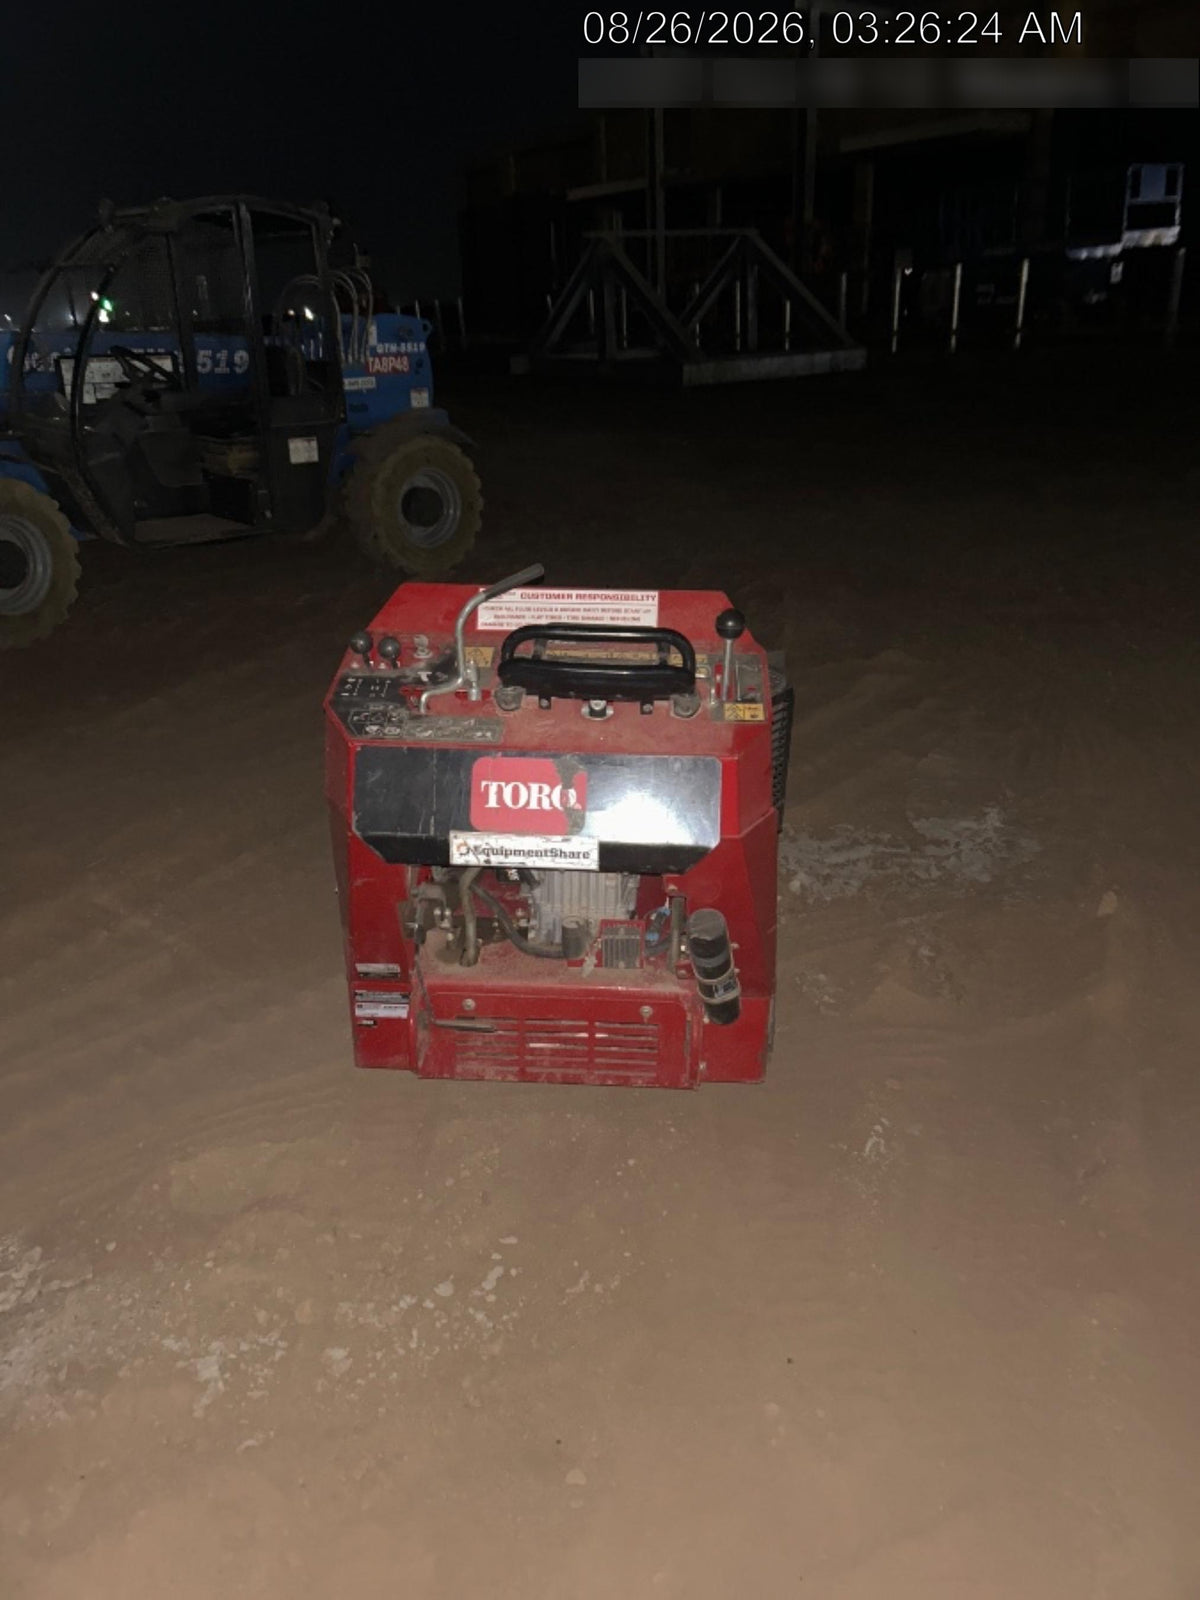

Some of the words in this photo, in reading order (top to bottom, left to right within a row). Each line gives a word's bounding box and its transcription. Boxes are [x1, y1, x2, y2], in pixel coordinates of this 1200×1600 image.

[520, 591, 573, 600] CUSTOMER
[575, 592, 657, 601] RESPONSIBILITY
[473, 842, 591, 860] EquipmentShare
